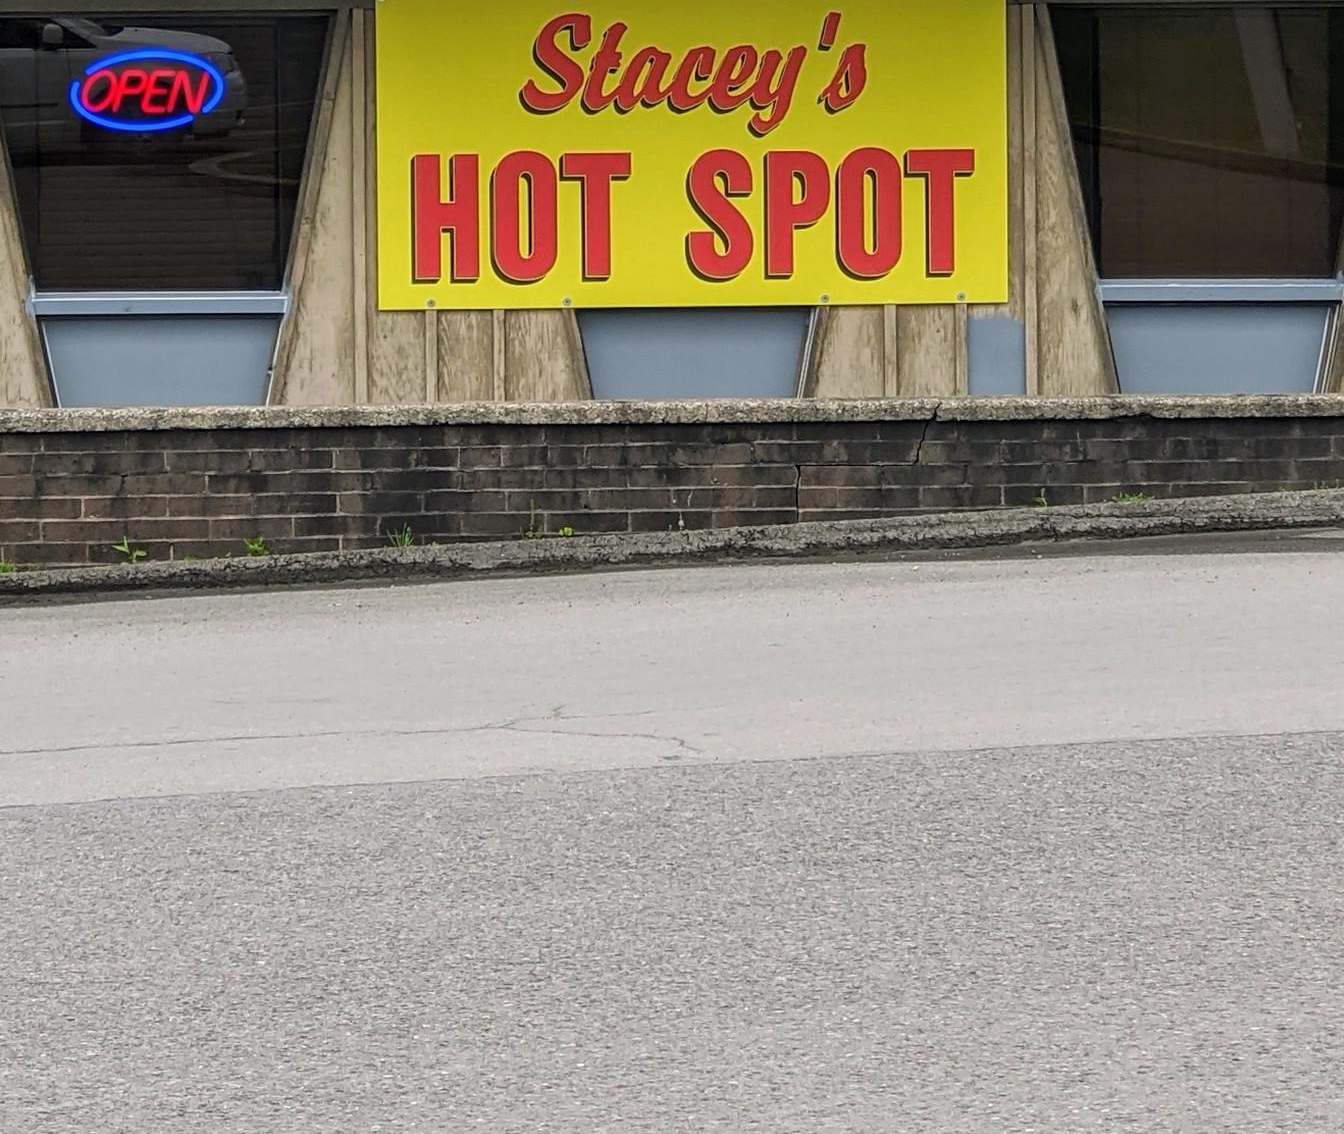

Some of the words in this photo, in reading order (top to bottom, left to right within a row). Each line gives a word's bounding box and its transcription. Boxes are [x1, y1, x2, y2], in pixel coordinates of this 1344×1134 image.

[80, 68, 211, 115] OPEN
[518, 10, 869, 138] Stacey's
[410, 149, 633, 286] HOT
[684, 146, 977, 284] SPOT
